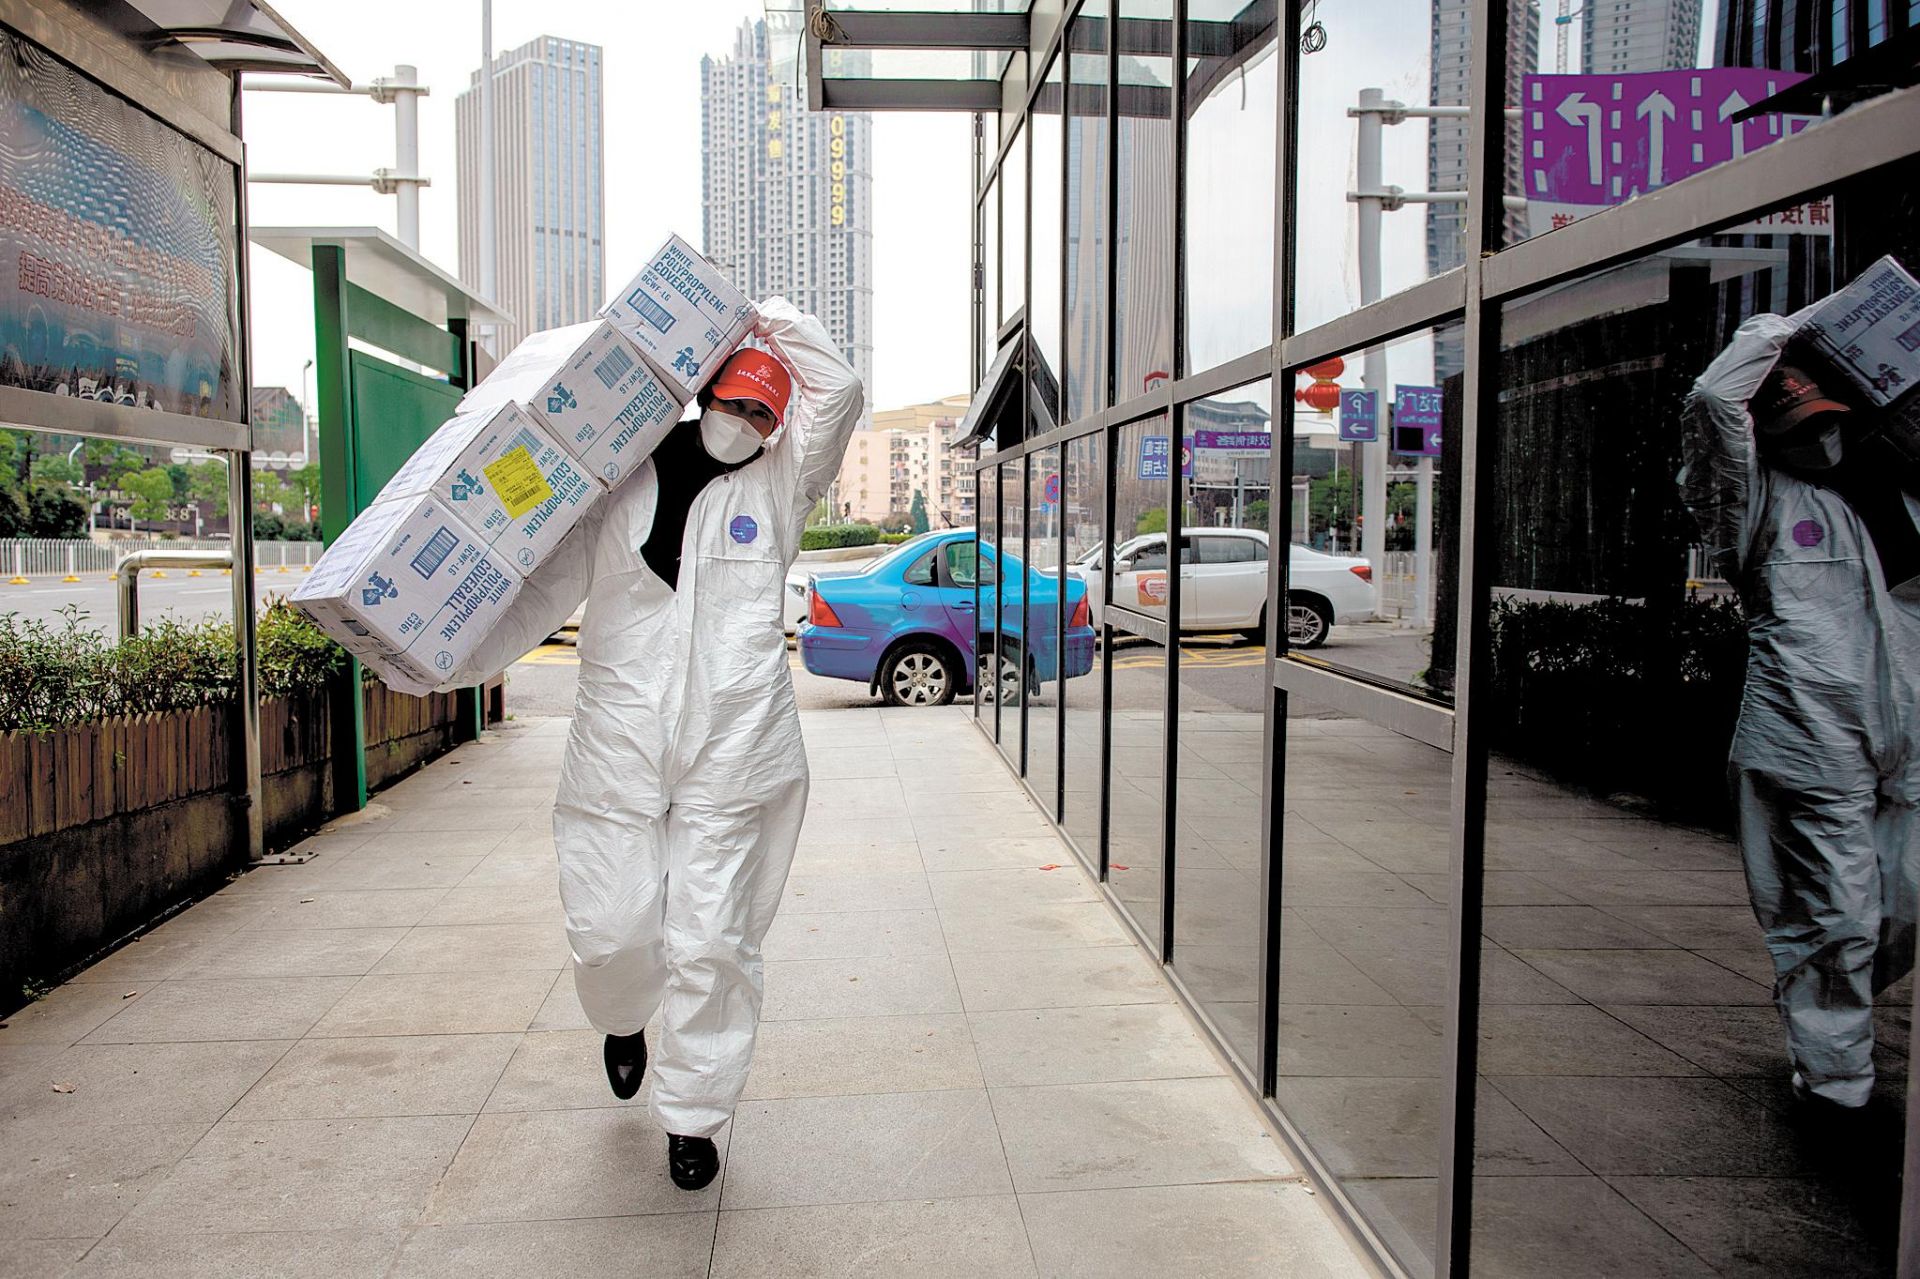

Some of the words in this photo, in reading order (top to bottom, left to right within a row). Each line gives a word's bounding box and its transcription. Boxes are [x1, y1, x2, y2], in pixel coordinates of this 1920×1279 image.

[670, 244, 694, 270] WHITE
[653, 261, 702, 308] COVERALL
[661, 252, 728, 315] POLYPROPYLENE
[609, 391, 667, 454] POLYPROPYLENE
[615, 382, 658, 426] COVERALL
[651, 401, 674, 426] WHITE
[522, 471, 582, 539] POLYPROPYLENE
[567, 481, 590, 507] WHITE
[447, 543, 476, 576] DCWF-LG
[439, 567, 503, 642] POLYPROPYLENE
[445, 558, 492, 610] COVERALL
[491, 578, 512, 605] WHITE
[399, 612, 419, 635] C3161
